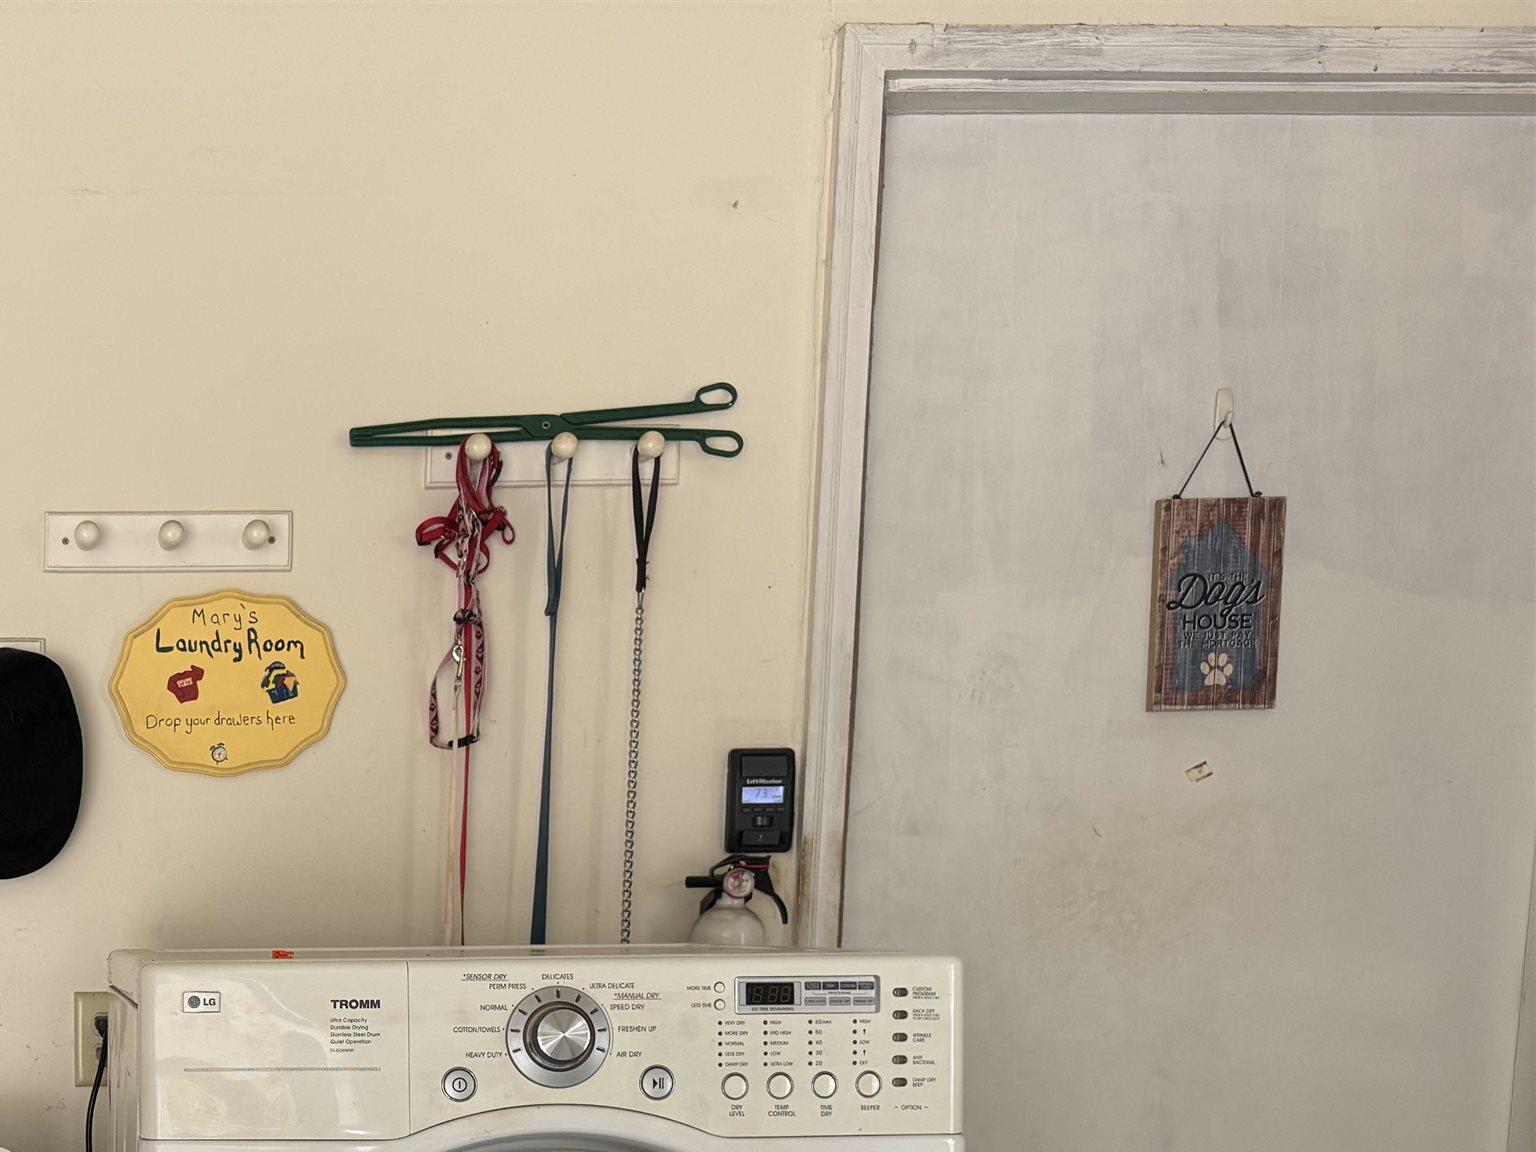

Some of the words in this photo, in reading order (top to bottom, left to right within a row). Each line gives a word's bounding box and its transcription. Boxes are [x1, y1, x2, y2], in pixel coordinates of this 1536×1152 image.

[192, 603, 259, 630] Mary's
[1183, 613, 1254, 630] HOUSE
[1204, 631, 1226, 640] JUST
[155, 628, 243, 662] Laundry
[247, 627, 305, 660] Room
[146, 714, 181, 732] Drop
[185, 717, 211, 734] your
[214, 710, 262, 726] drawers
[266, 710, 296, 731] here
[754, 788, 768, 798] 73
[203, 998, 216, 1006] LG
[330, 999, 381, 1009] TROMM
